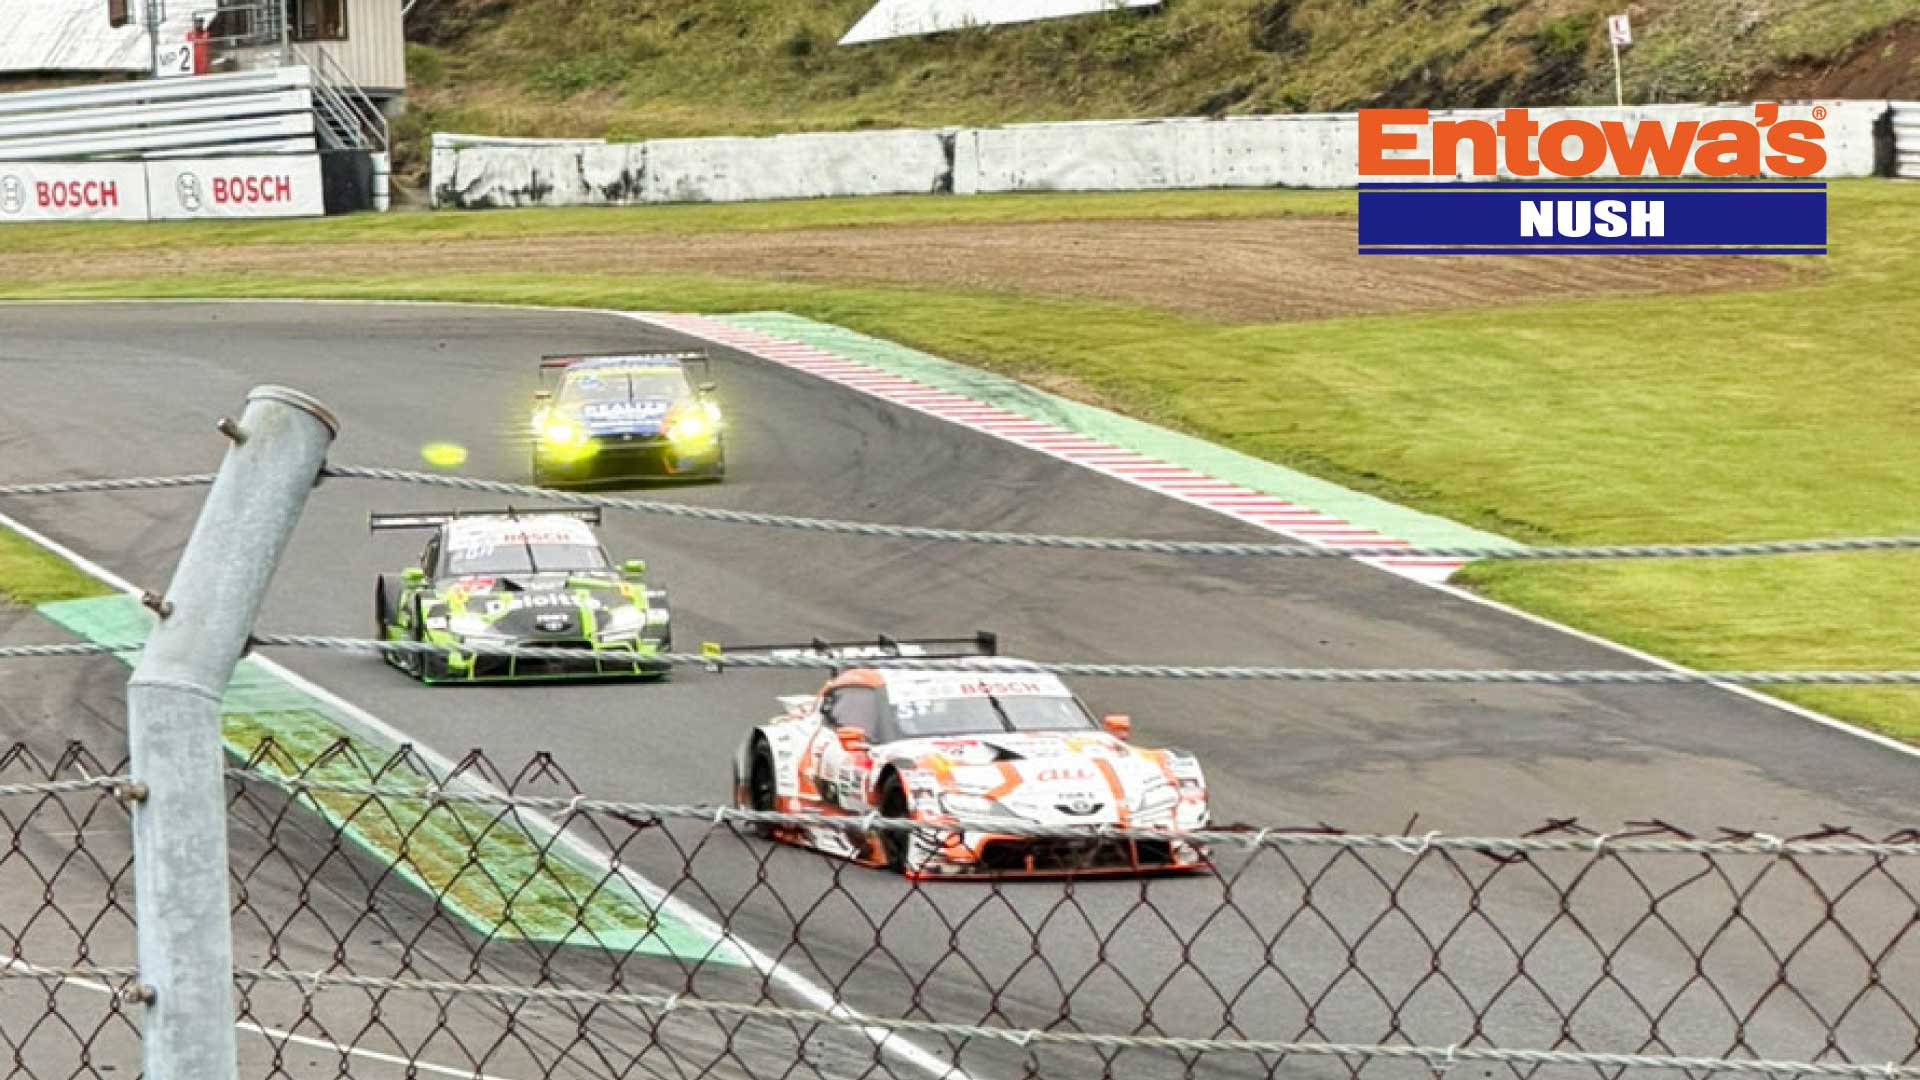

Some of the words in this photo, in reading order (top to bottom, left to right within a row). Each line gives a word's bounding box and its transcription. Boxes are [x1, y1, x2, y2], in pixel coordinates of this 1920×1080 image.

[179, 46, 190, 71] 2
[36, 181, 118, 207] BOSCH
[213, 175, 291, 204] BOSCH
[960, 682, 1041, 695] BOSCH
